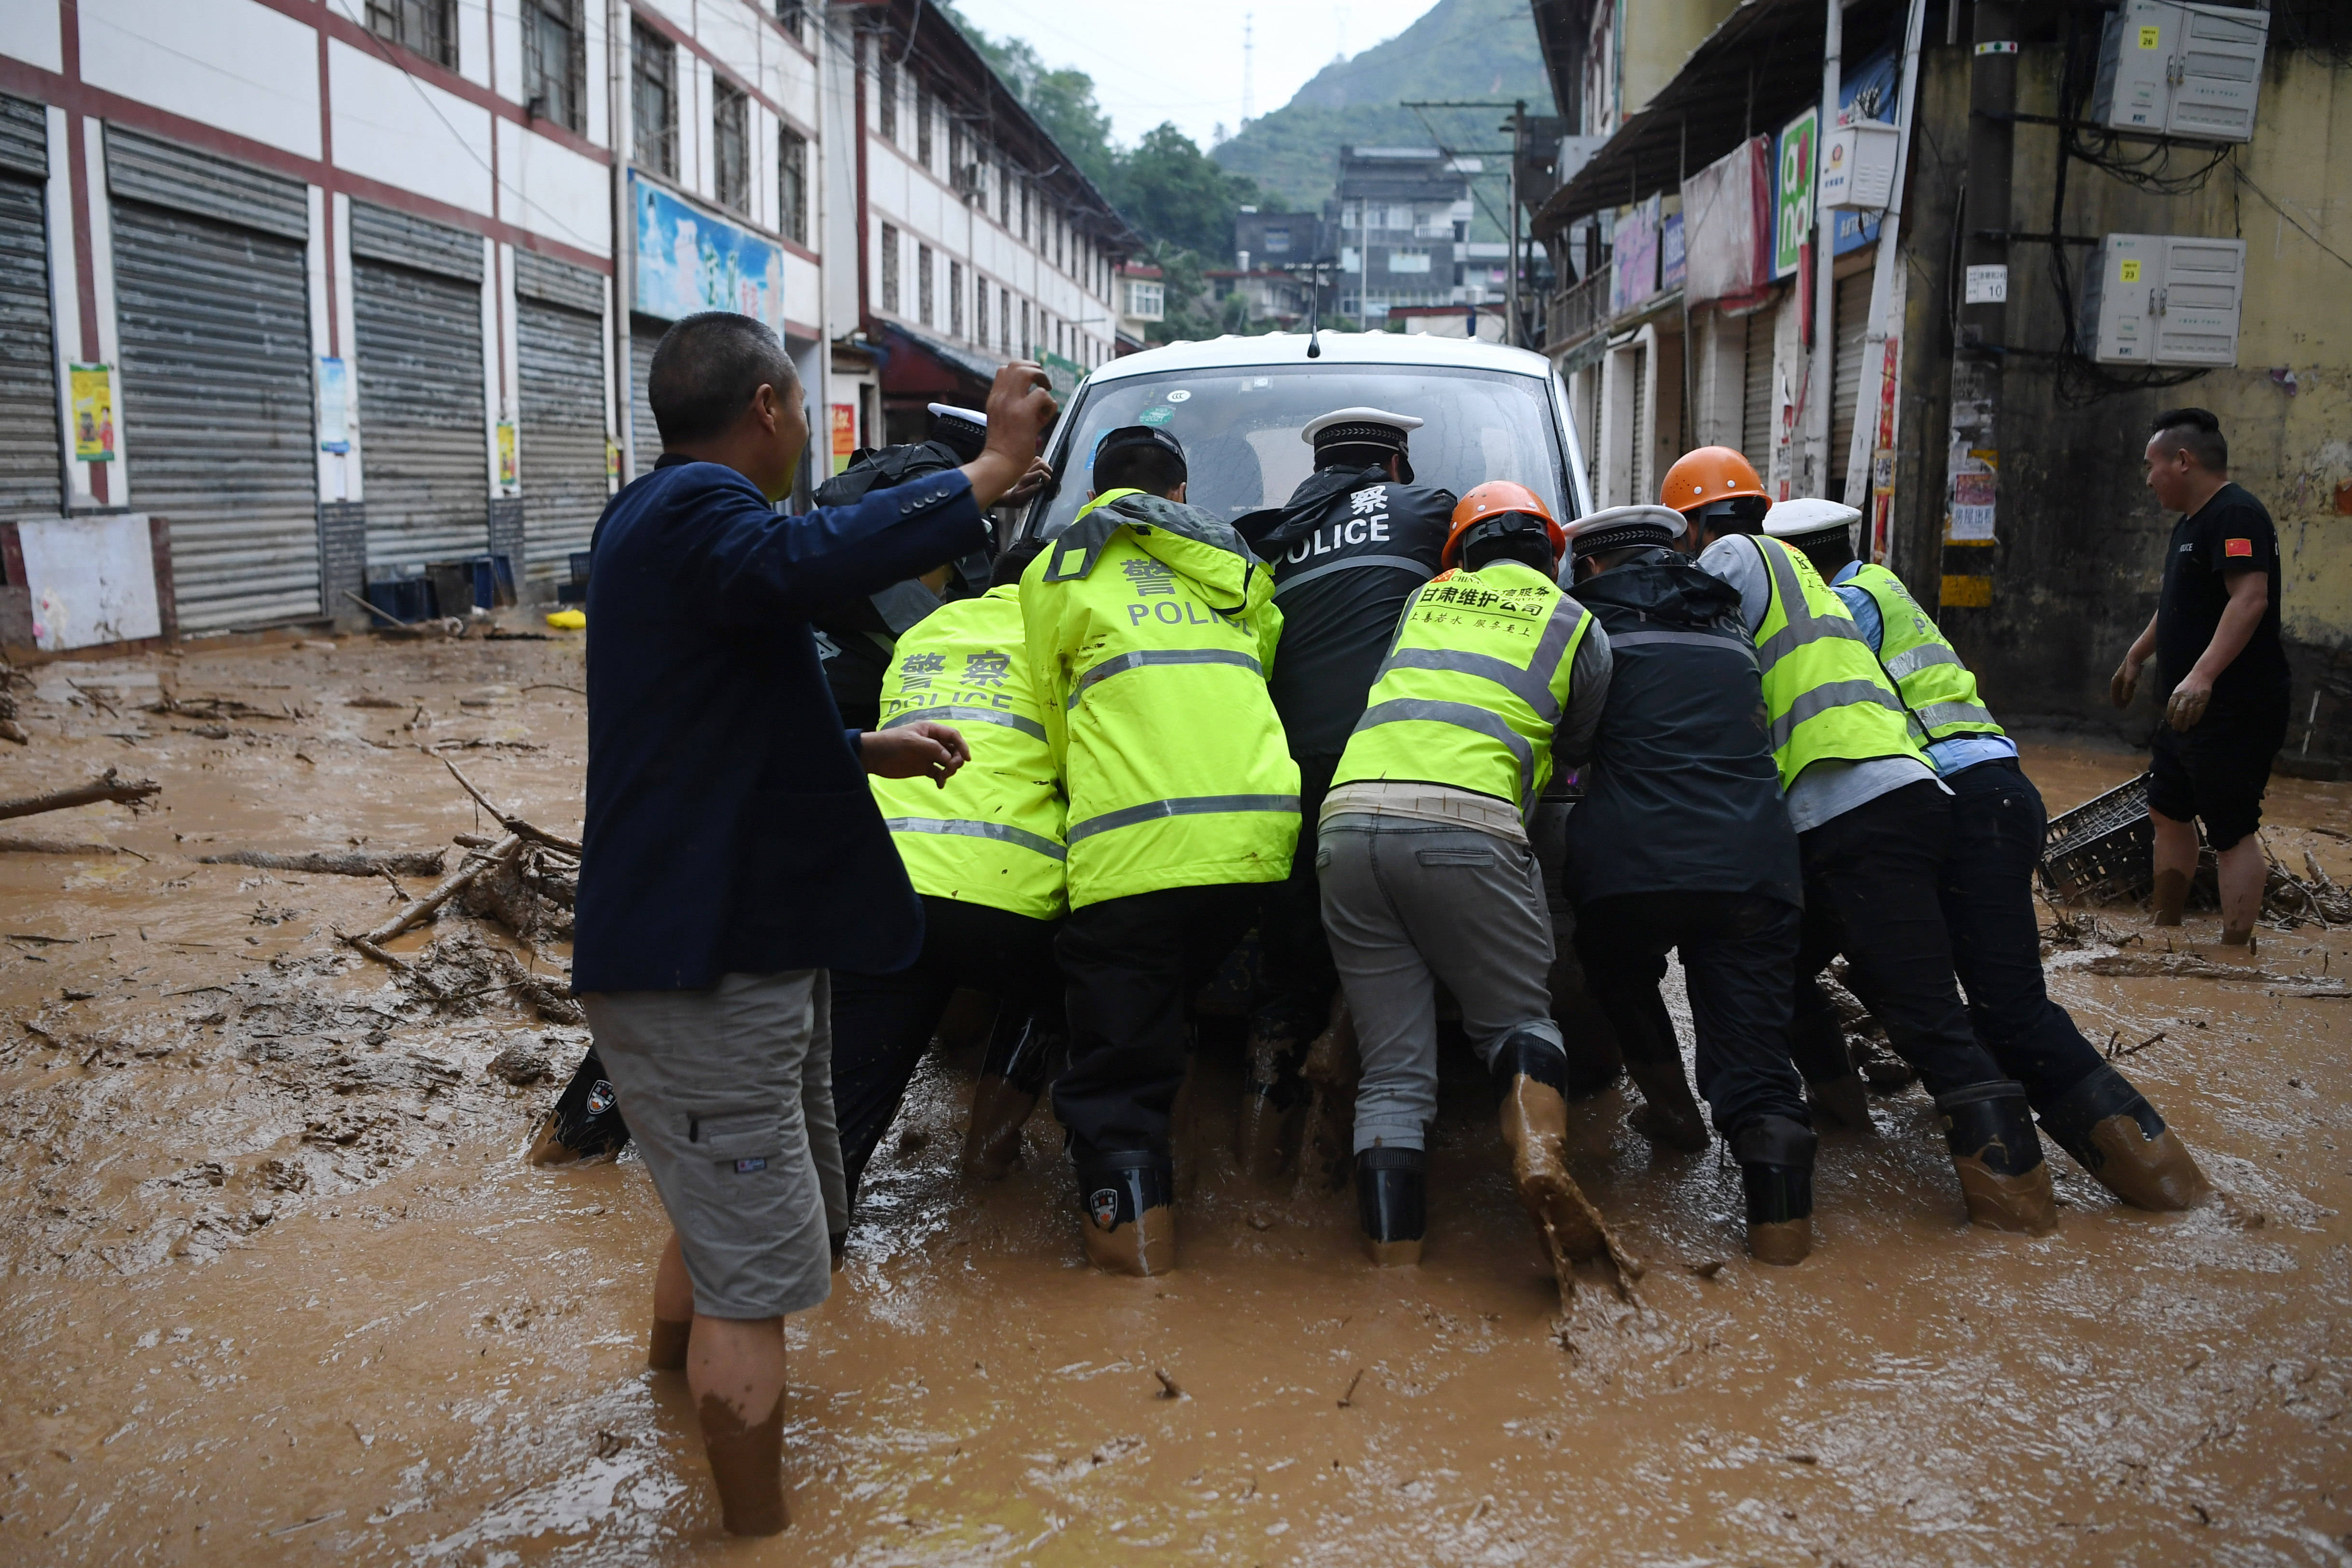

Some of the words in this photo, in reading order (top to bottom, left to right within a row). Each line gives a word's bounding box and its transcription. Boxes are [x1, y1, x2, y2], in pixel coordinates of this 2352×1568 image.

[1989, 285, 2002, 298] 10
[1270, 513, 1390, 575] OLICE
[1120, 559, 1176, 597] 警
[1420, 586, 1543, 616] 甘肃维护公司
[1409, 611, 1463, 625] 上善若水
[1472, 618, 1530, 638] 服务至上
[899, 650, 1011, 693] 警察
